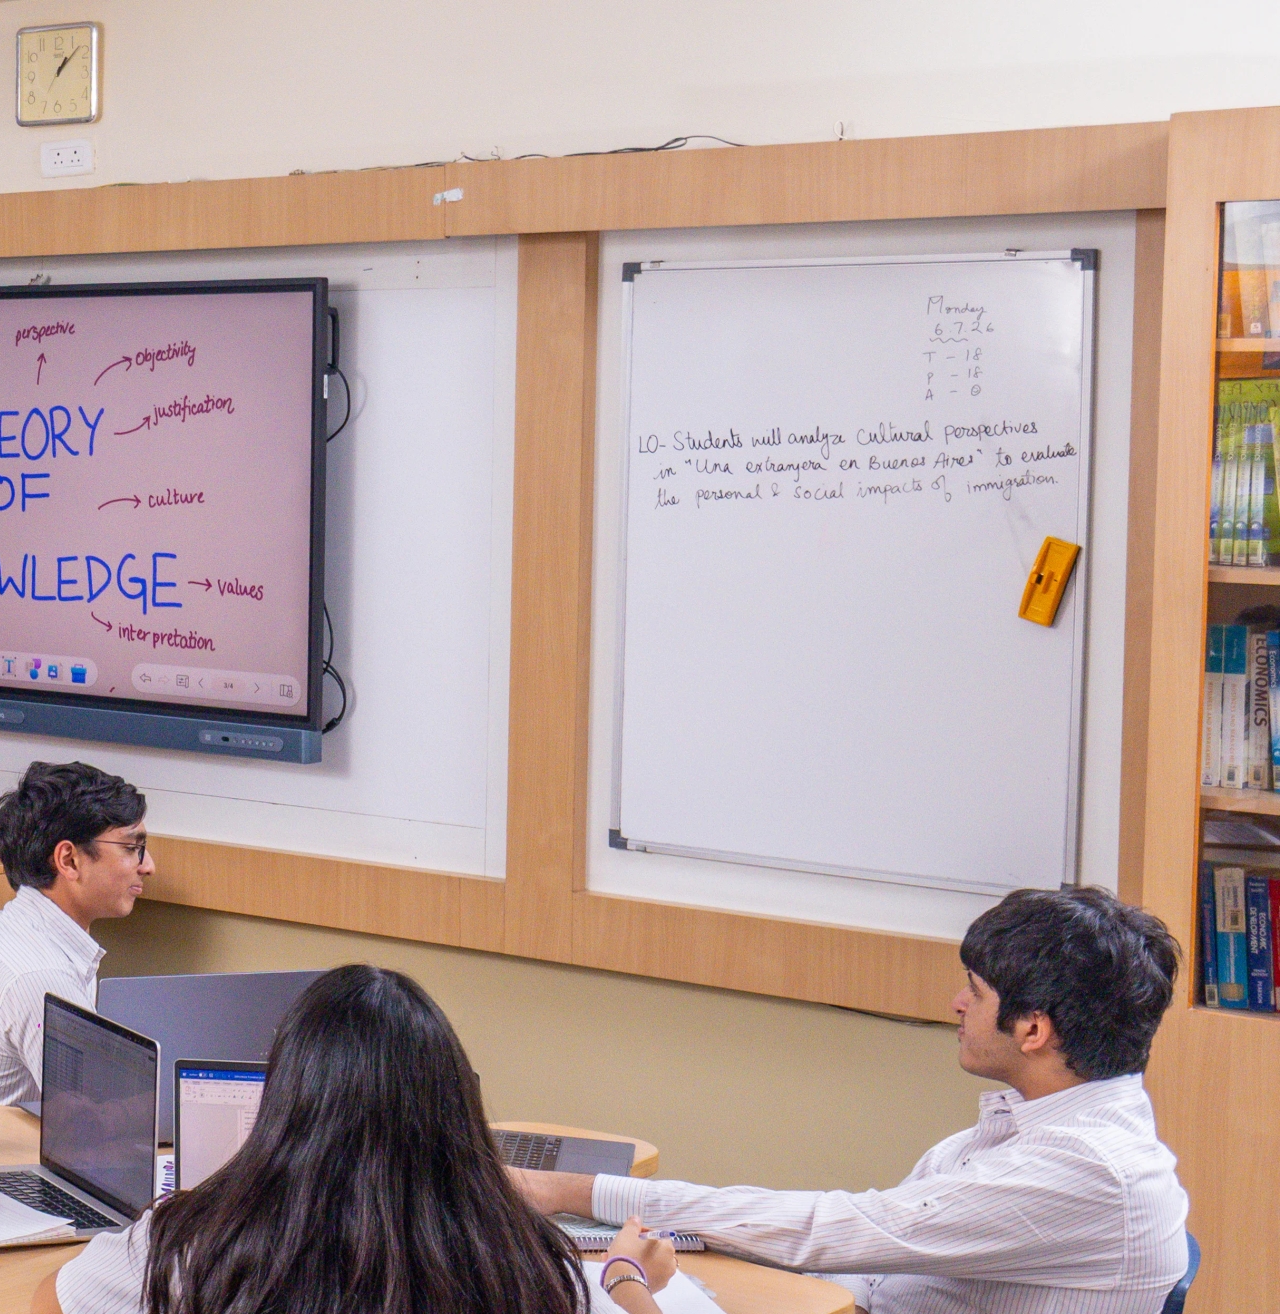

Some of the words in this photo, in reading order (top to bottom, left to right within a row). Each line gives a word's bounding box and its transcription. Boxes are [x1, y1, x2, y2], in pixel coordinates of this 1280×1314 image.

[54, 36, 64, 51] 12
[81, 44, 90, 60] 2
[27, 50, 38, 64] 10
[27, 71, 36, 84] 9
[81, 65, 89, 80] 3
[27, 90, 36, 105] 8
[81, 86, 88, 101] 4
[40, 100, 48, 114] 7
[53, 99, 62, 114] 6
[69, 98, 77, 113] 5
[926, 295, 987, 321] Monday
[15, 320, 76, 347] perspective
[922, 351, 937, 363] T
[966, 347, 983, 361] 18
[926, 371, 934, 386] P
[967, 366, 983, 379] 18
[924, 388, 934, 401] A
[152, 394, 236, 426] justification
[672, 427, 743, 451] Students
[750, 427, 782, 447] will
[1227, 423, 1237, 461] Economics
[1240, 423, 1250, 461] Economics
[1254, 423, 1264, 461] Economics
[652, 463, 677, 480] in
[839, 458, 861, 471] en
[868, 455, 927, 471] Buenos
[995, 446, 1013, 468] to
[1020, 442, 1078, 463] evaluate
[148, 488, 206, 509] culture
[654, 488, 681, 510] the
[695, 483, 761, 509] personal
[856, 477, 923, 504] impacts
[930, 474, 952, 503] of
[966, 469, 1059, 501] immigration.
[117, 621, 216, 652] interpretation
[1269, 650, 1277, 688] Economics
[222, 680, 235, 691] 3/4
[1253, 637, 1268, 727] ECONOMICS
[1249, 907, 1258, 955] DEVELOPMENT
[1259, 912, 1267, 950] ECONOMIC
